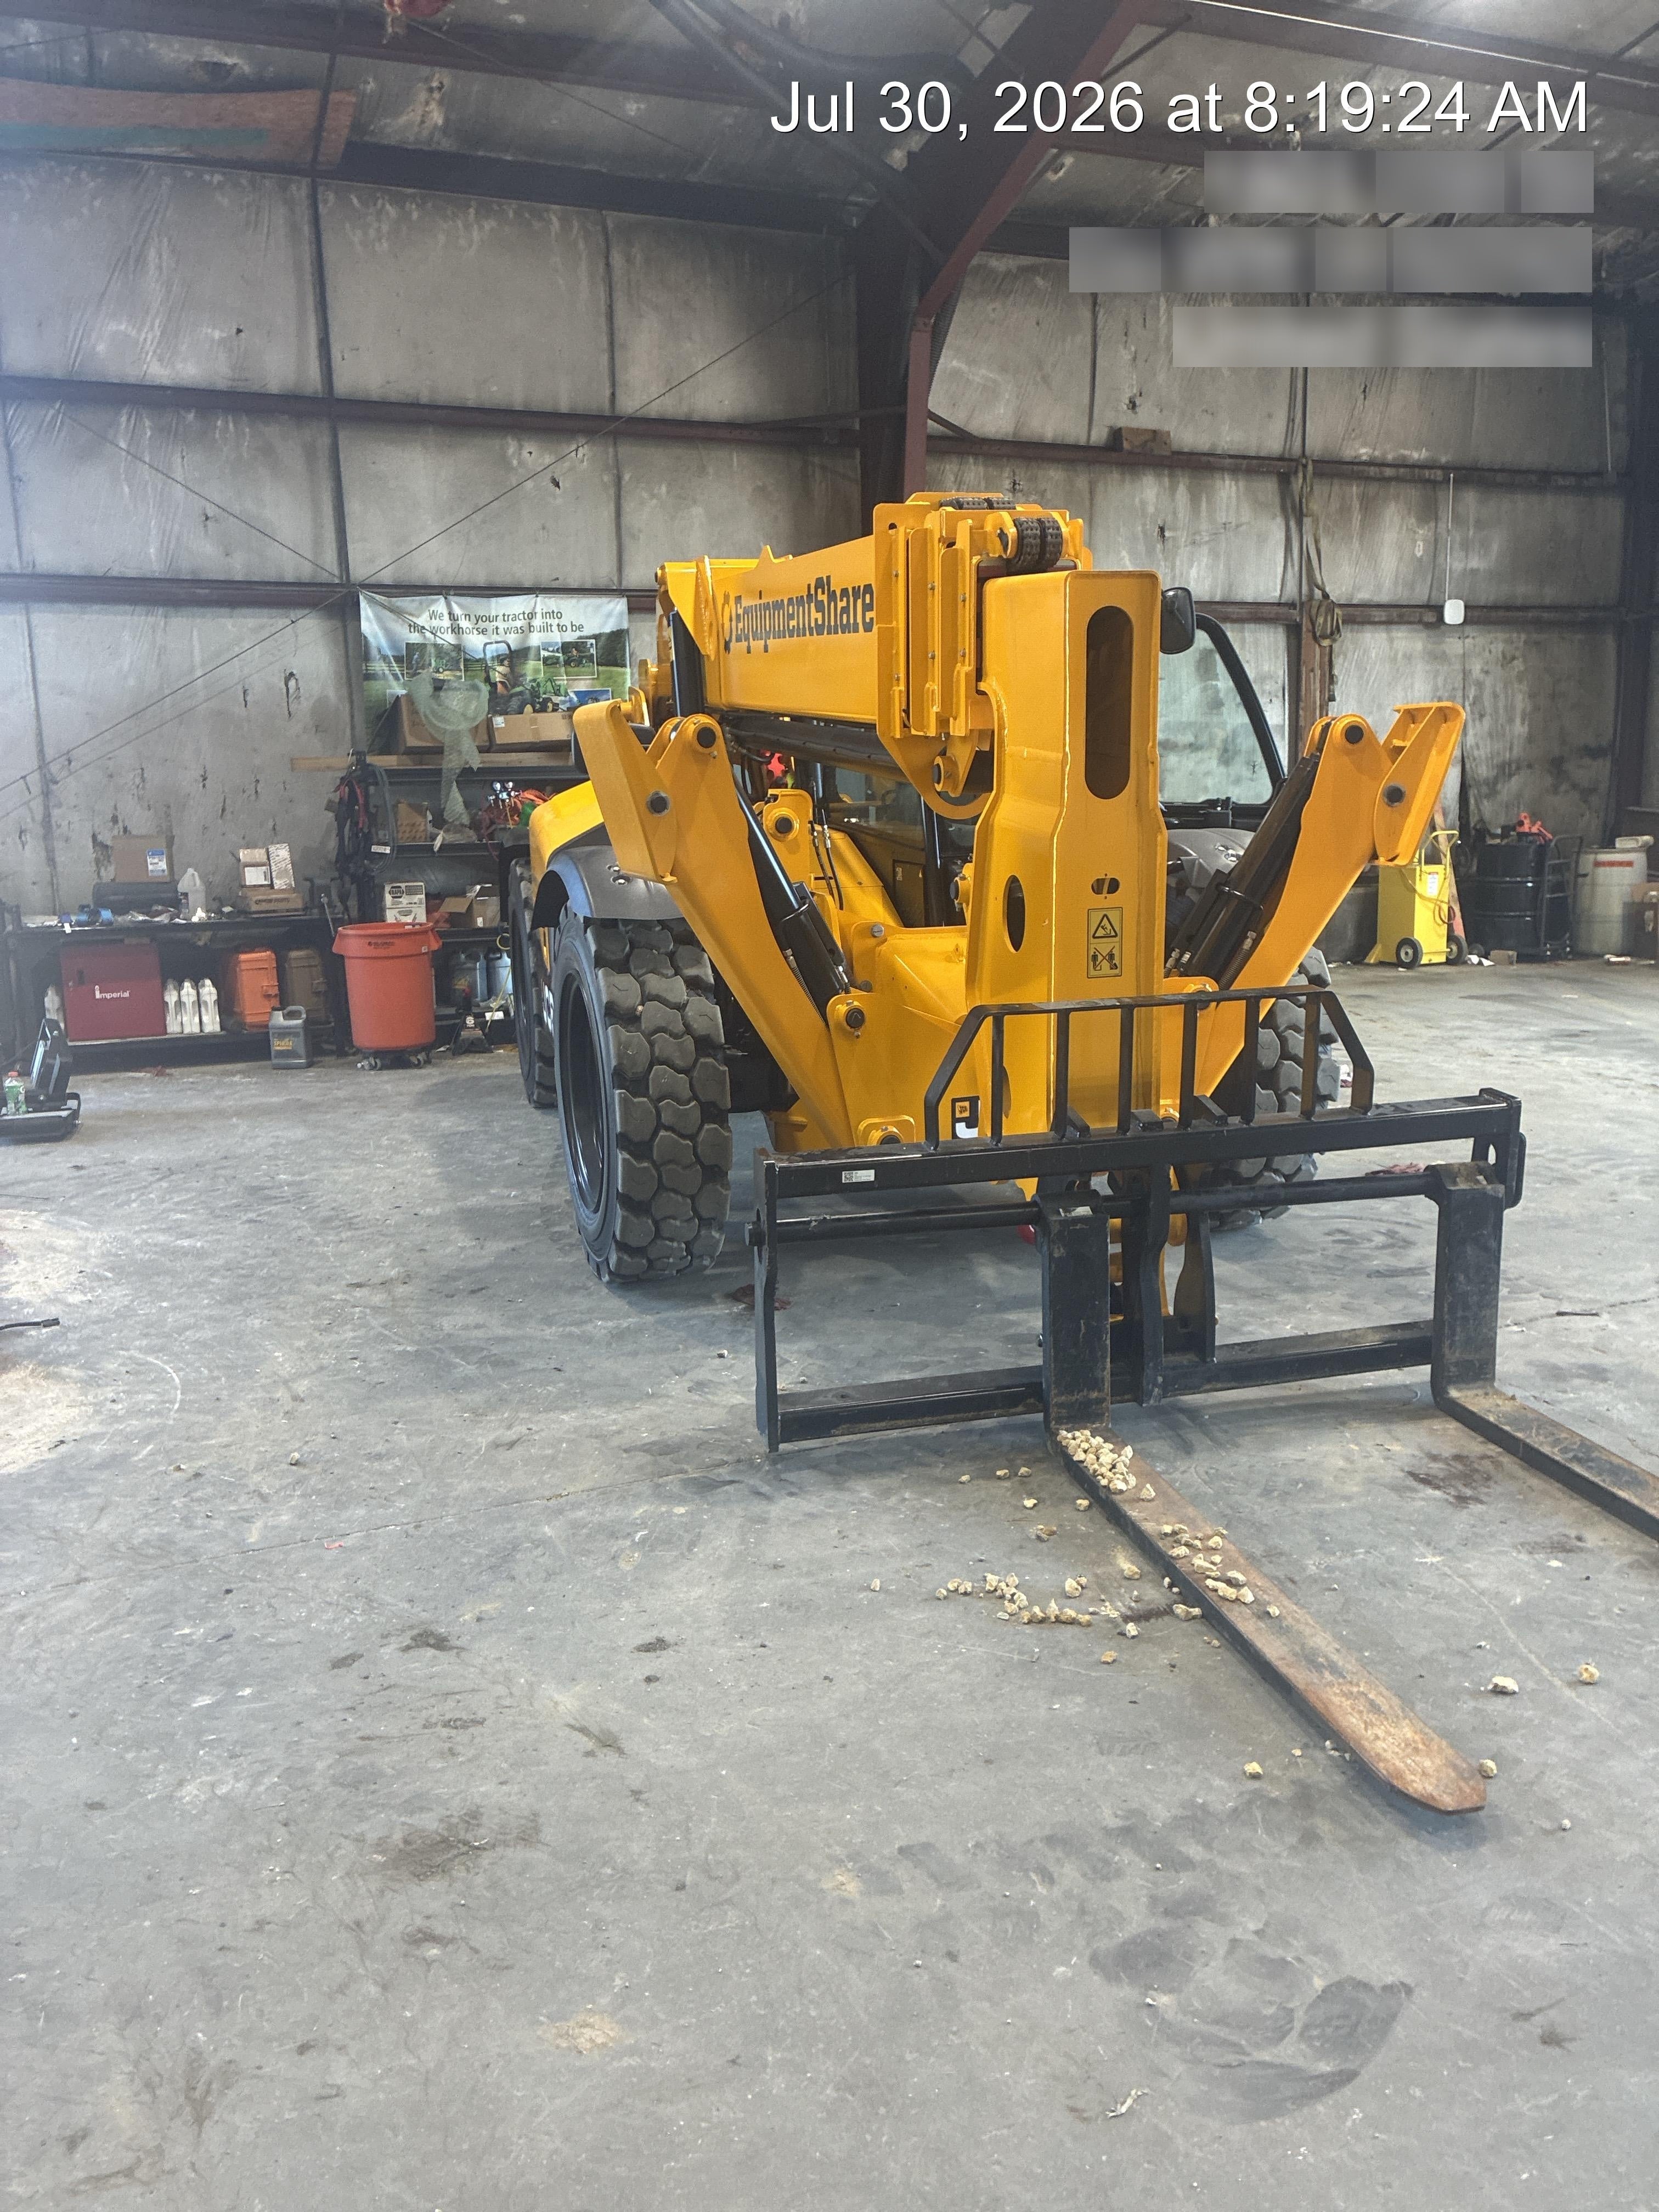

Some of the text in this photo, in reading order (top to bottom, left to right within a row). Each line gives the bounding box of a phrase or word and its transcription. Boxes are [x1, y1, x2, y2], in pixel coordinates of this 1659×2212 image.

[428, 608, 563, 625] We turn your tractor into
[735, 575, 874, 654] EquipmentShare
[408, 620, 584, 635] the workhorse it was built to be
